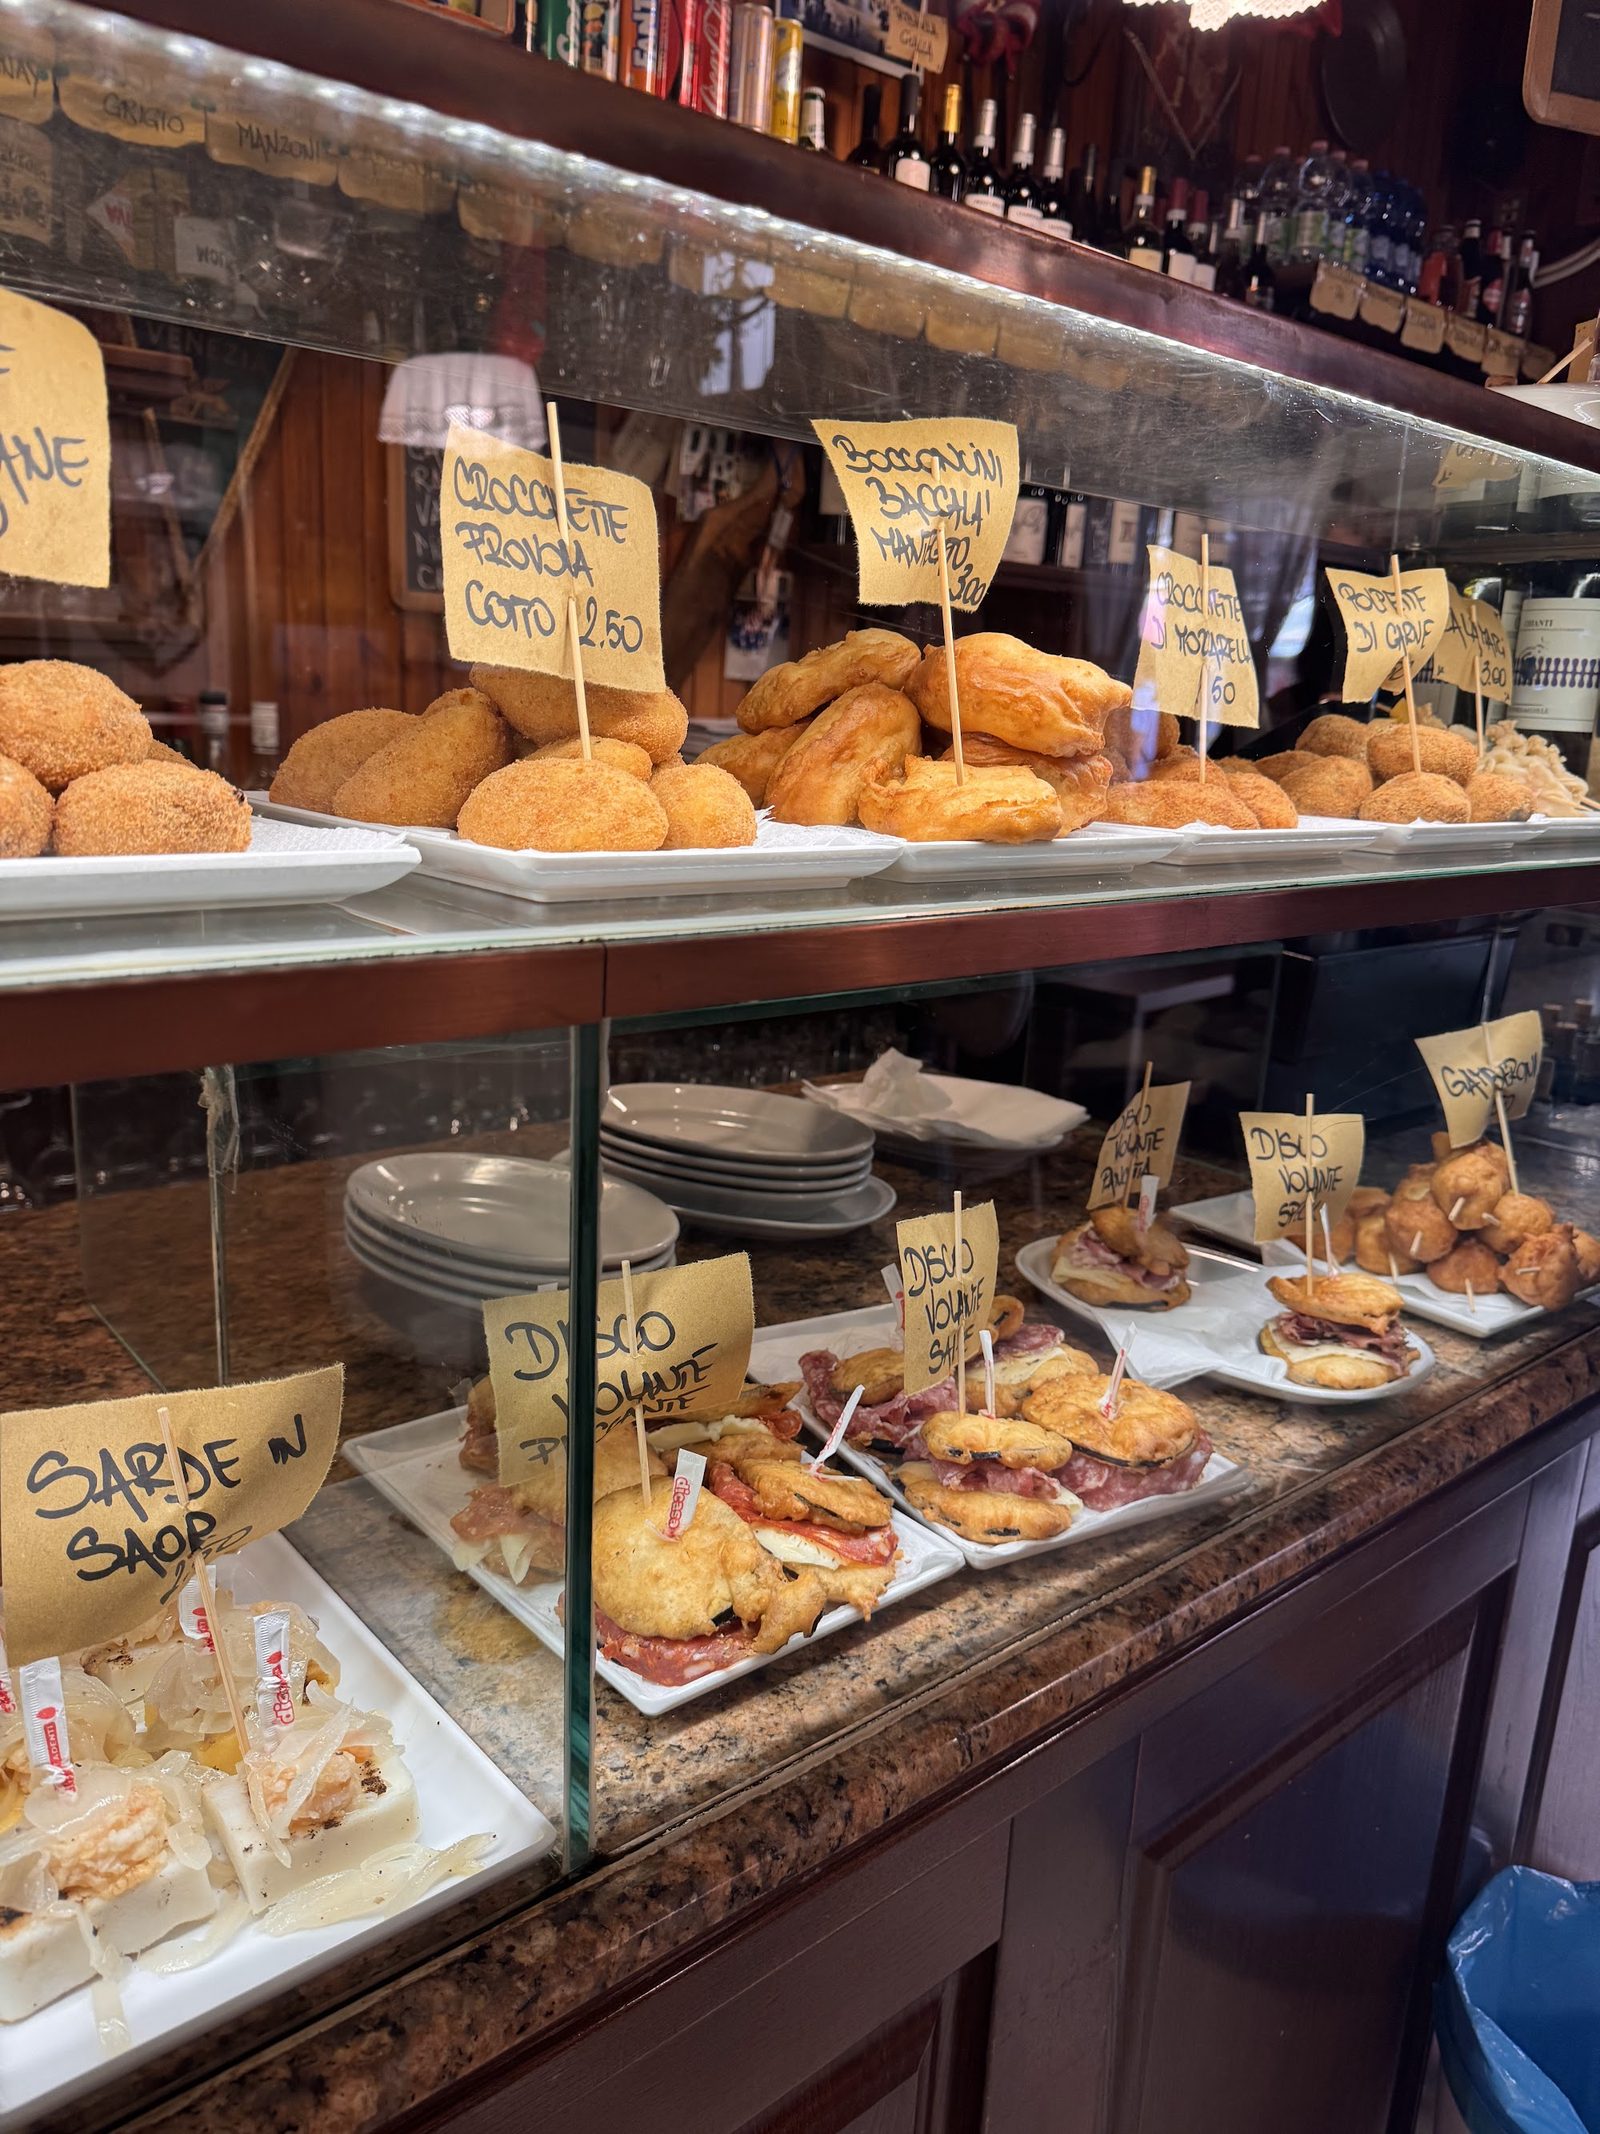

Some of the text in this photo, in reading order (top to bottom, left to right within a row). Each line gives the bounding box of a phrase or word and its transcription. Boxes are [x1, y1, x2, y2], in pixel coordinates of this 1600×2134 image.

[103, 93, 185, 133] GRIGIO
[236, 121, 320, 161] MANZONI
[465, 580, 643, 653] COTTO 2.50
[1353, 621, 1377, 653] DI
[26, 1413, 307, 1523] SARDE IN
